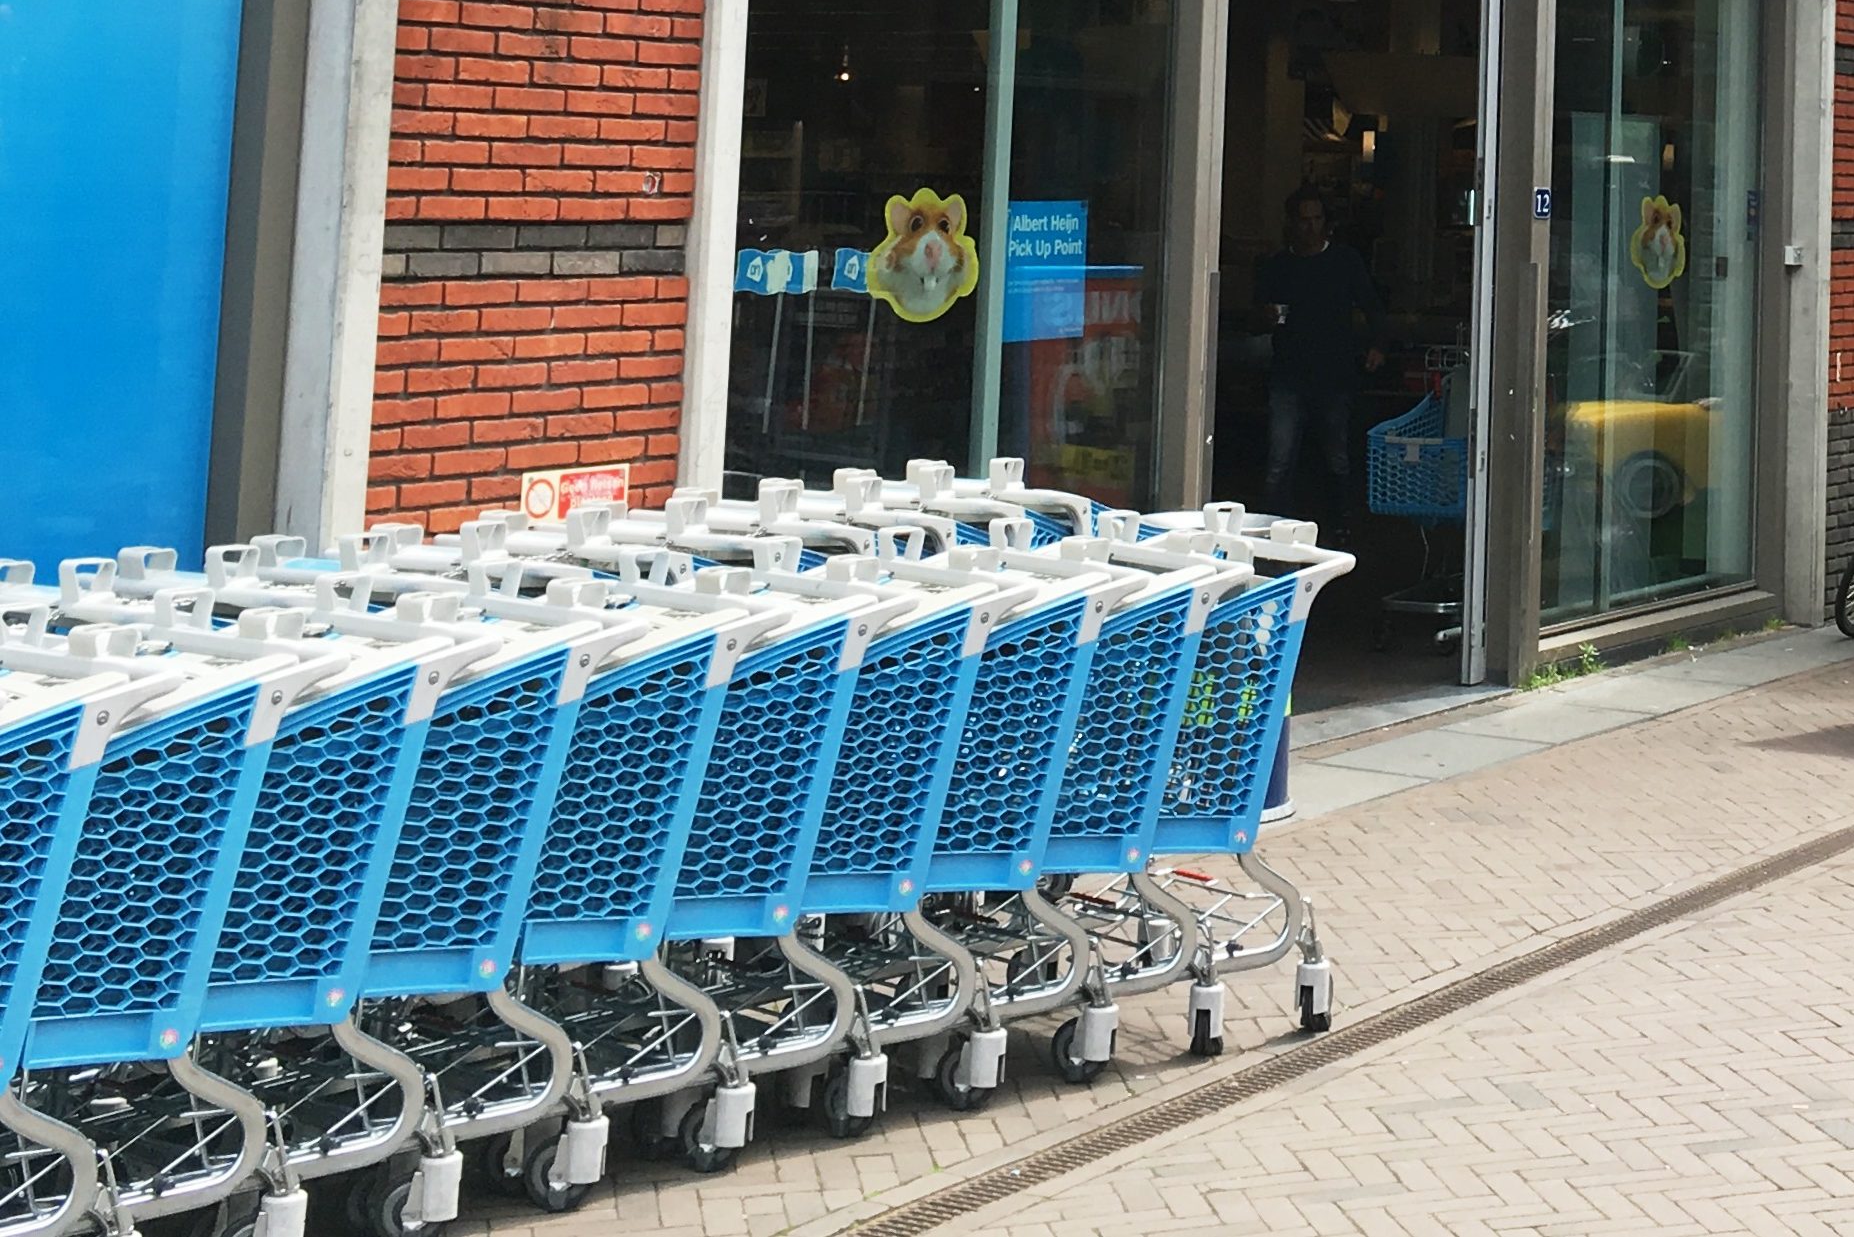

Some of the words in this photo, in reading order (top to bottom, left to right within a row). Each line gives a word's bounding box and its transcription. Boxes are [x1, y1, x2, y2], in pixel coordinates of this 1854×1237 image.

[1536, 194, 1550, 213] 12
[1013, 215, 1048, 231] Albert
[1050, 214, 1079, 234] Heijn
[1008, 239, 1033, 257] Pick
[1035, 239, 1052, 260] Up
[1053, 238, 1083, 255] Point
